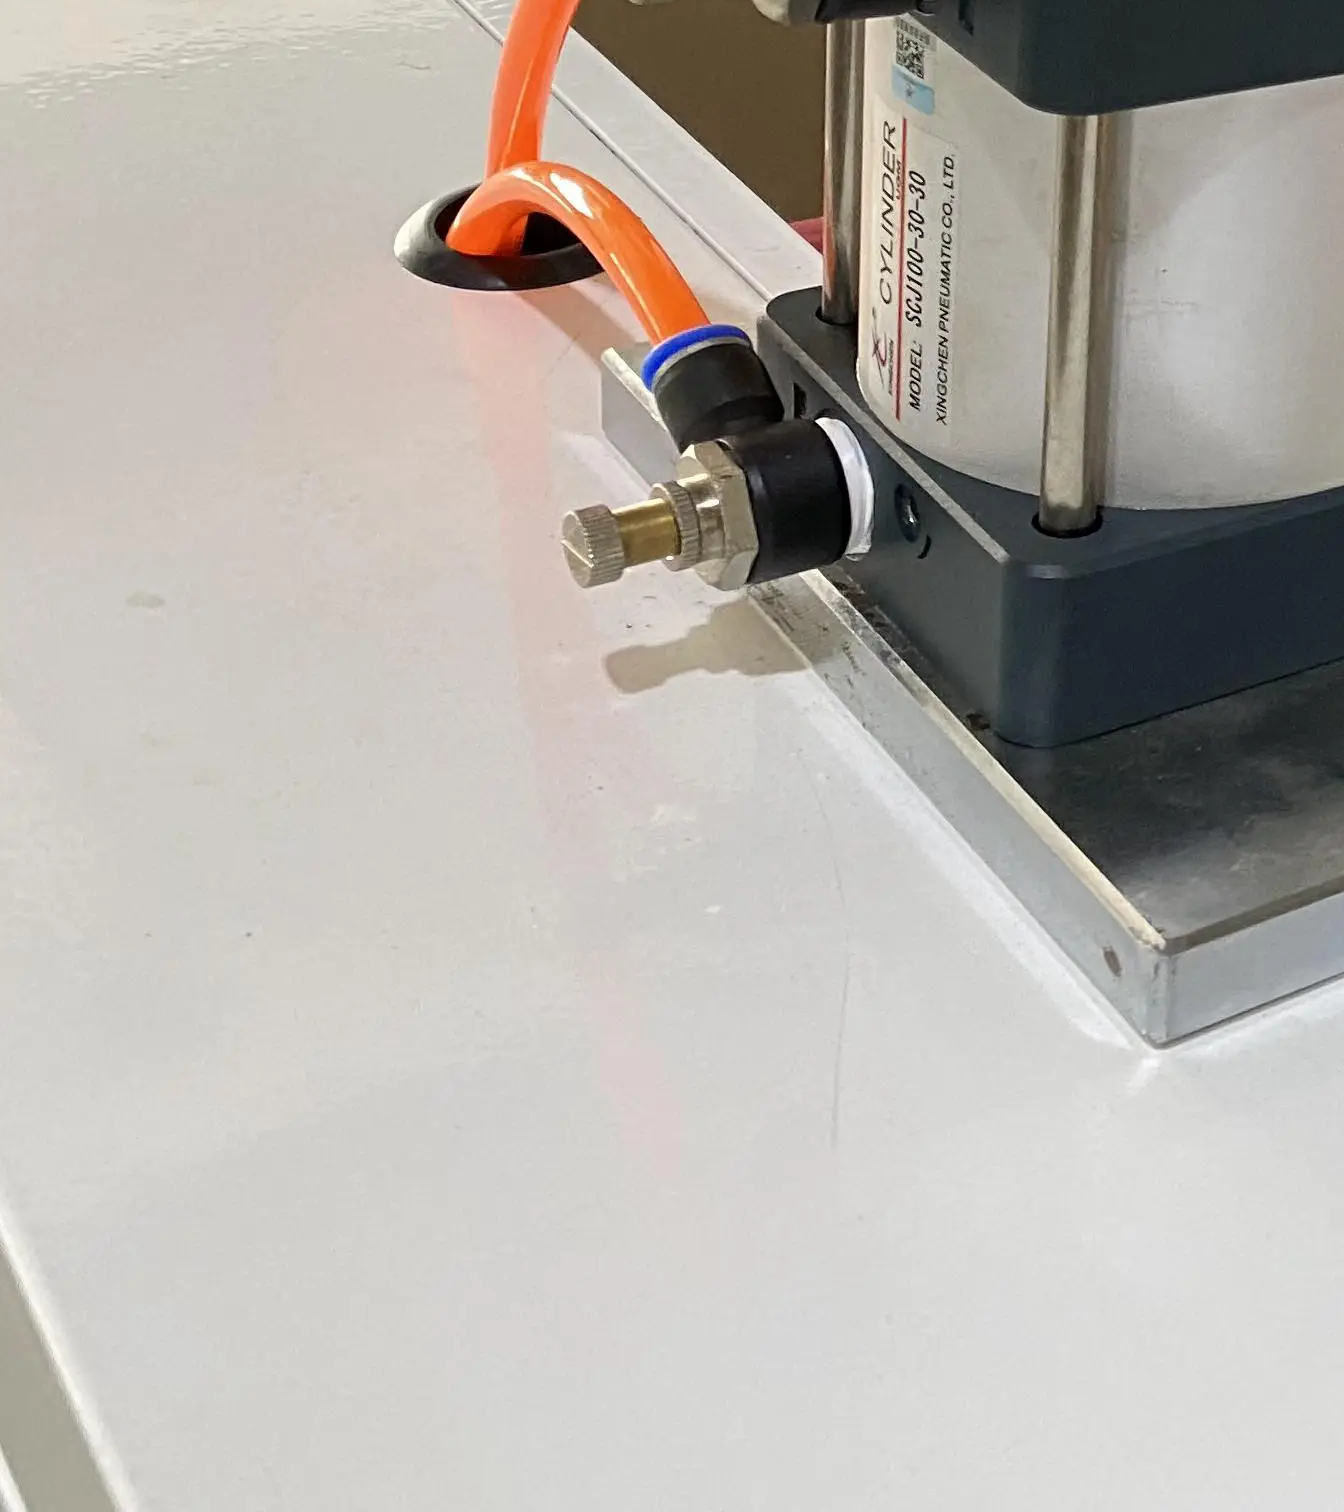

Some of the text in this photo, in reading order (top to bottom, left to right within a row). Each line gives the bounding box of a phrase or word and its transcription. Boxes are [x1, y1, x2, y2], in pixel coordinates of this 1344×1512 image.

[880, 121, 897, 304] CYLINDER
[943, 153, 957, 189] LTD.
[904, 170, 926, 411] MODEL: SCJ100-30-30
[939, 232, 952, 332] PNEUMATIC
[935, 335, 949, 425] XINGCHEN
